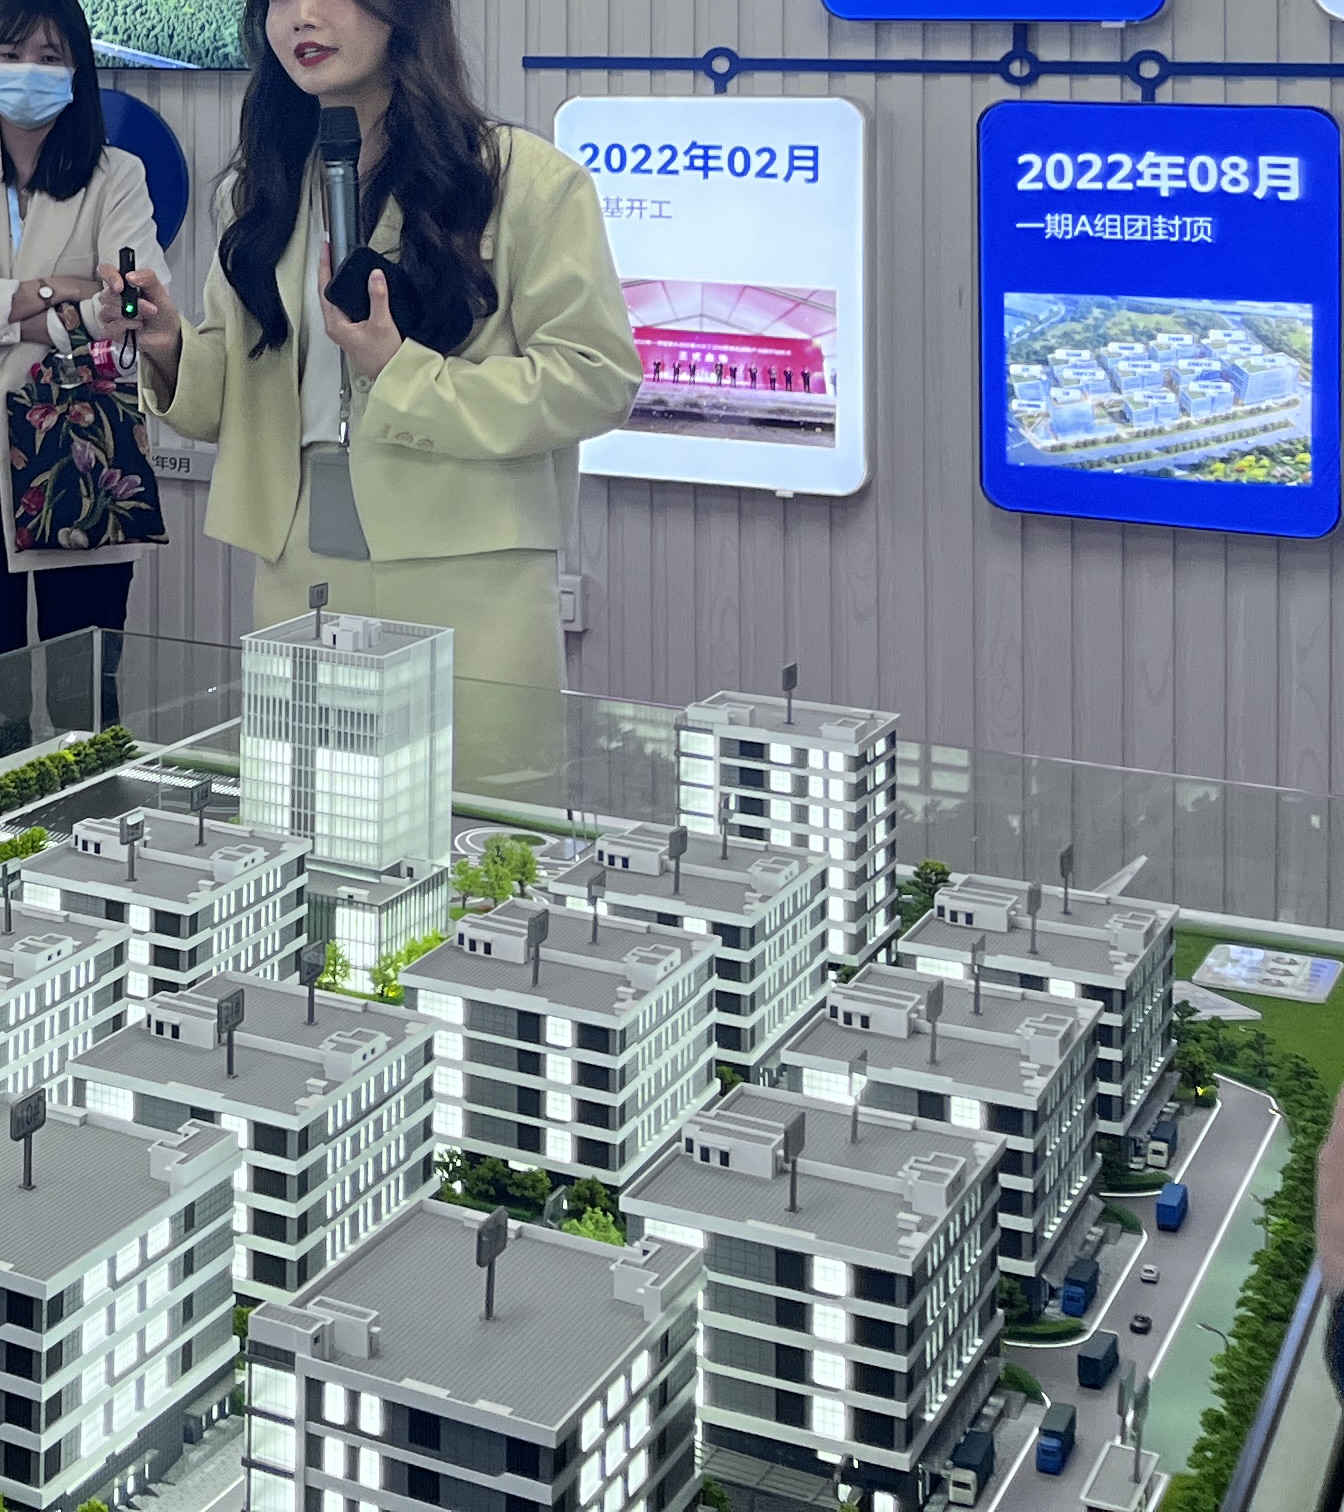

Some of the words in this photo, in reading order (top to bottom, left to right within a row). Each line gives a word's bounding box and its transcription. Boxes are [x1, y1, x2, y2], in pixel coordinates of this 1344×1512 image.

[578, 140, 820, 184] 2022年02月
[1016, 150, 1300, 201] 2022年08月
[1015, 213, 1213, 243] 一期A组团封顶
[151, 456, 192, 473] 年9月
